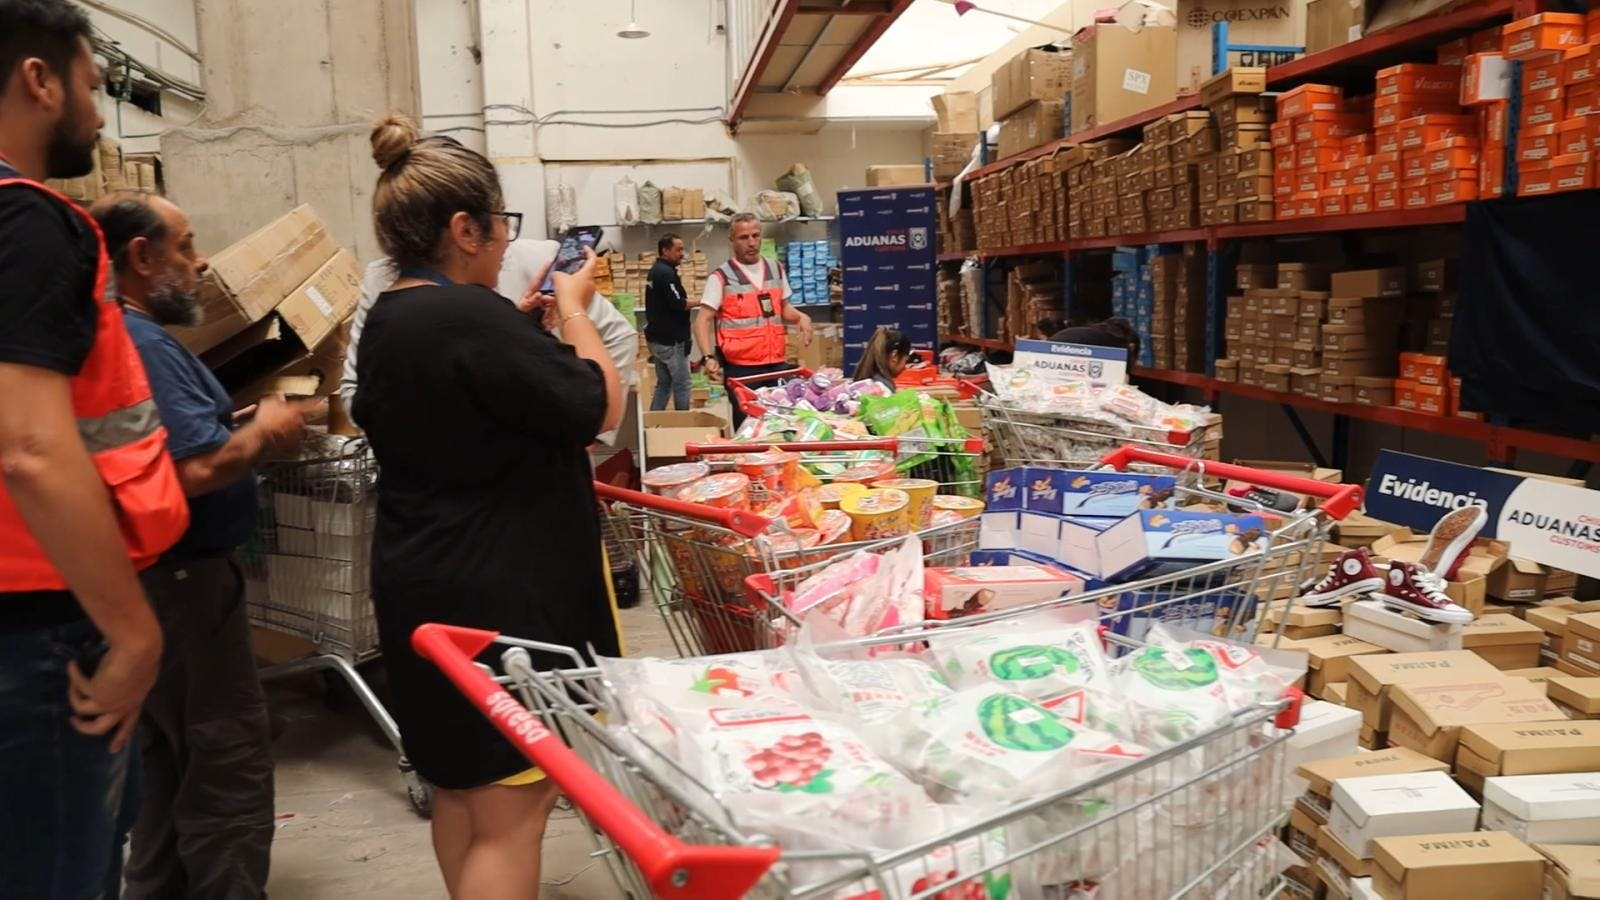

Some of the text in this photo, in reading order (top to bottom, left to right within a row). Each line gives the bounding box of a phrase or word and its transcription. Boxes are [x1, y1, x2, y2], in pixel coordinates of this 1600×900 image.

[845, 235, 906, 247] ADUANAS
[1050, 344, 1092, 355] Evidencia
[1034, 361, 1085, 372] ADUANAS
[1508, 509, 1600, 542] ADUANAS
[1418, 839, 1491, 851] PARMA
